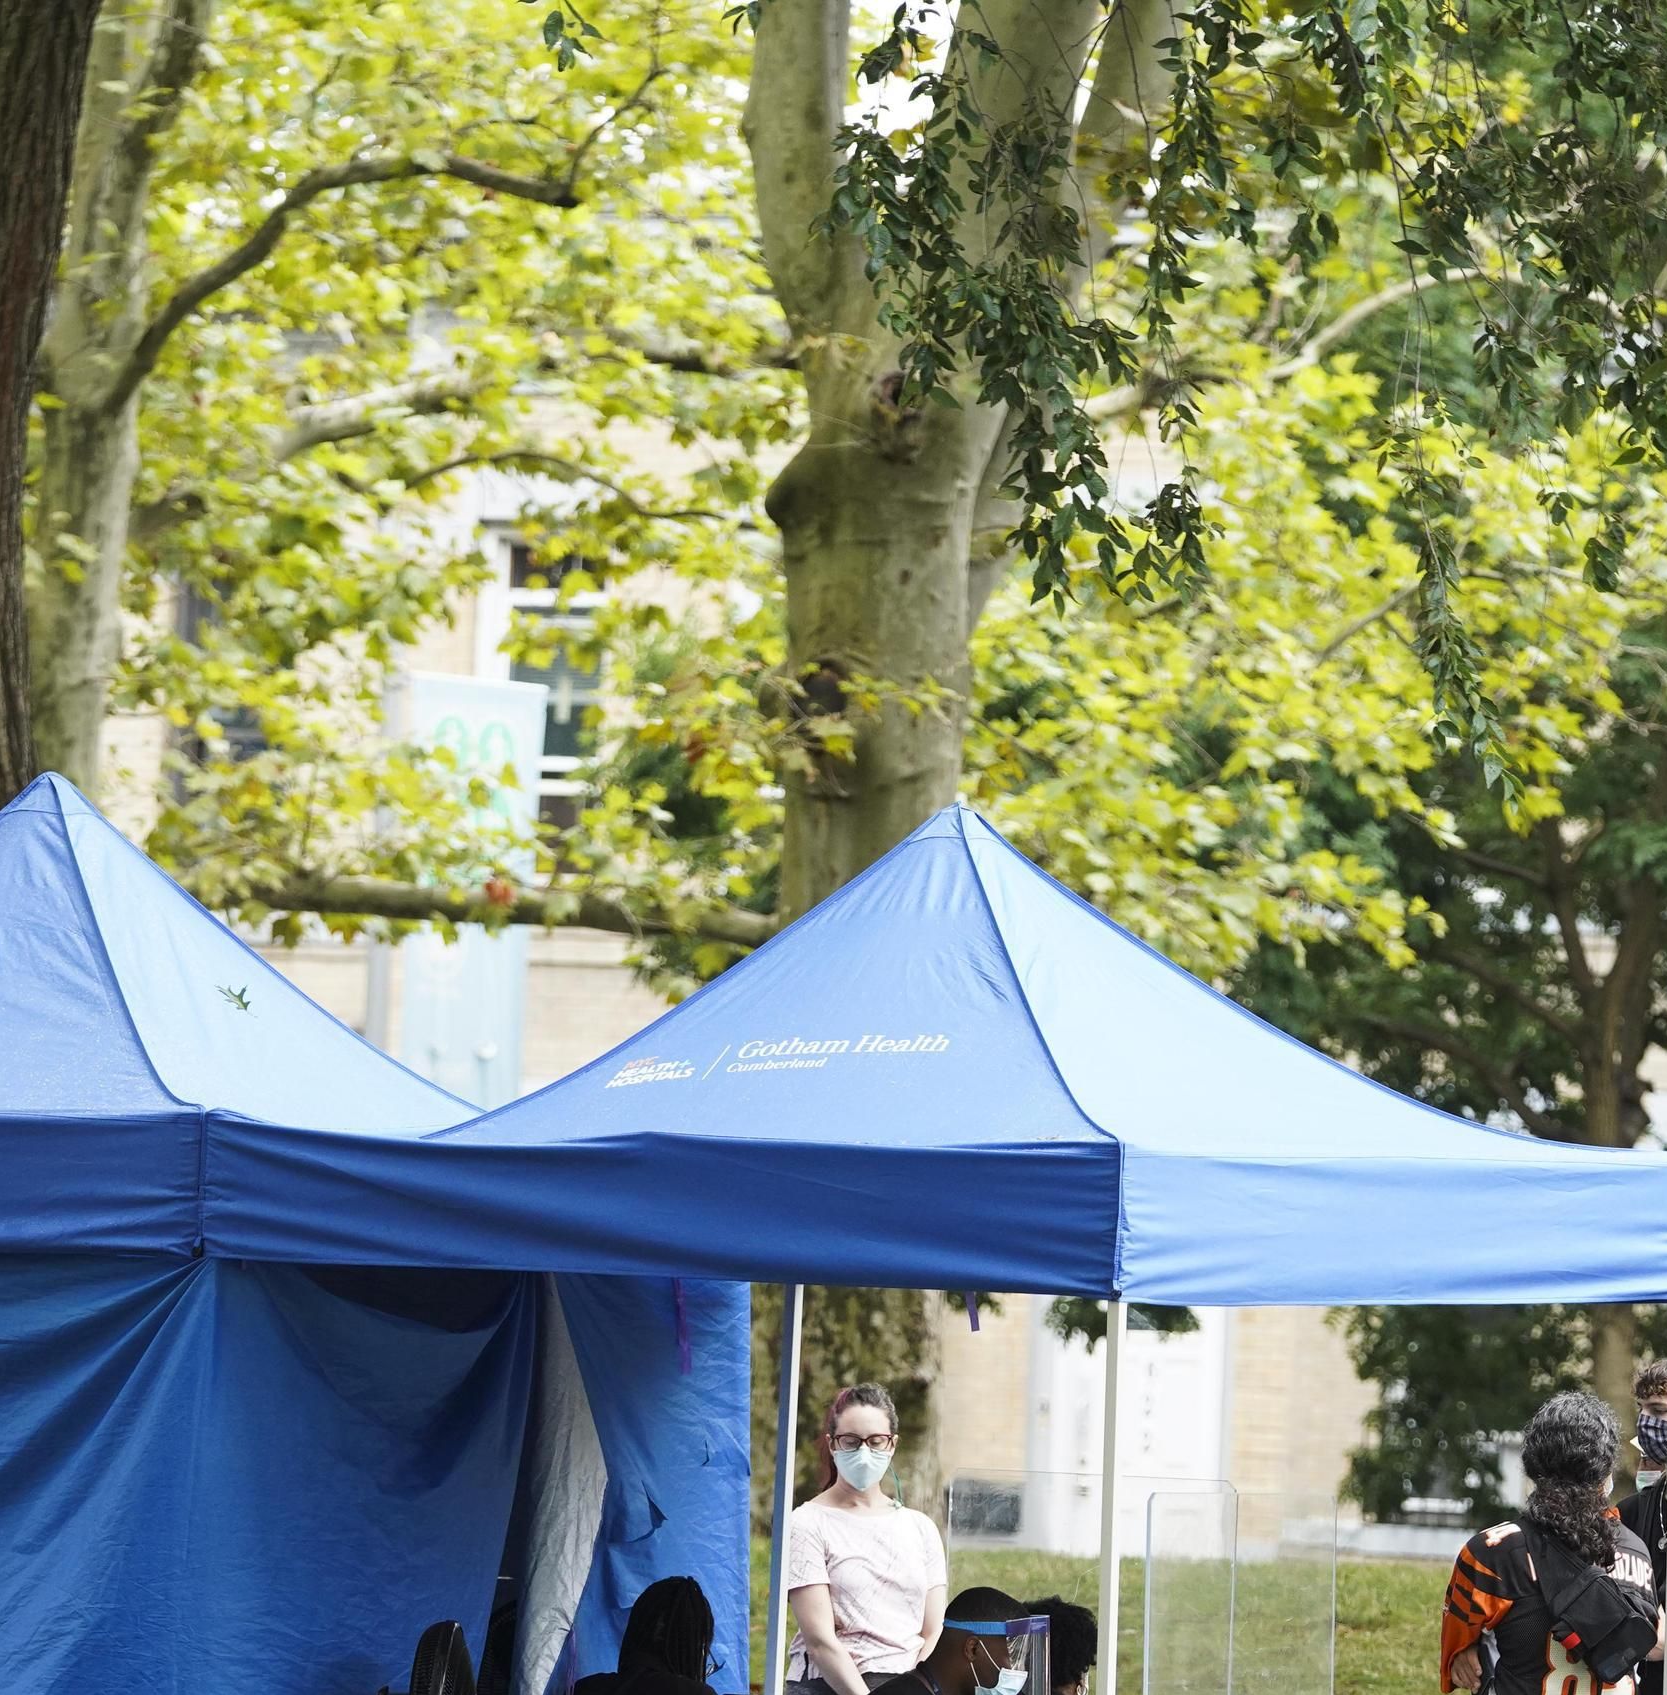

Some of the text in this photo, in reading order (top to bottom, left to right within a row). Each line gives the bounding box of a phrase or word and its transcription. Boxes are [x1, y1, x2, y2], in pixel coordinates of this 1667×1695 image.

[737, 1034, 951, 1059] Gotham Health
[726, 1057, 828, 1073] Cumberland
[604, 1067, 696, 1088] HOSPITALS
